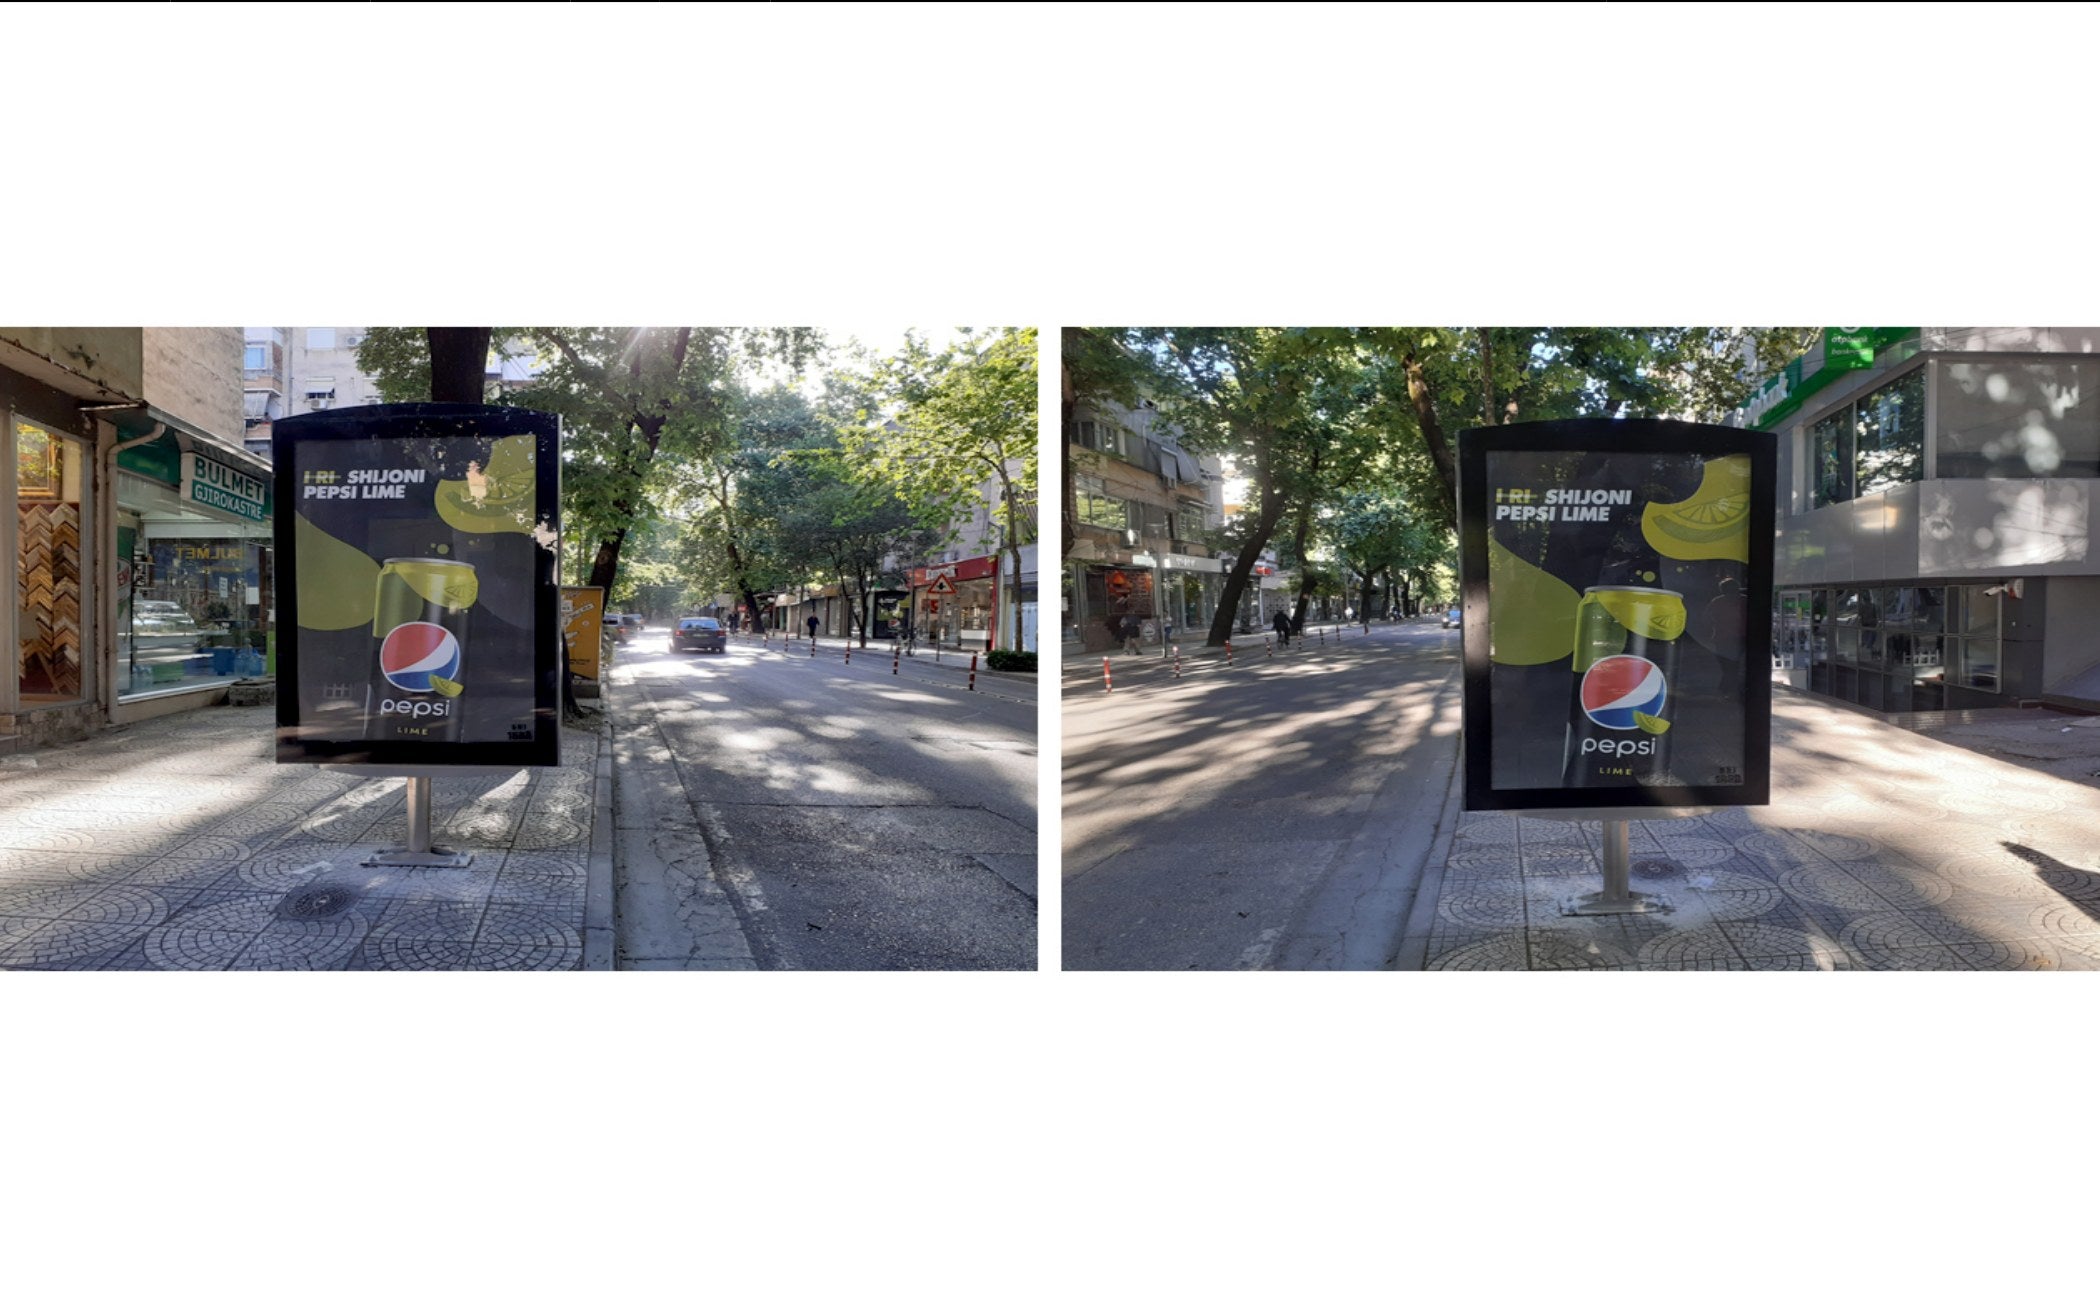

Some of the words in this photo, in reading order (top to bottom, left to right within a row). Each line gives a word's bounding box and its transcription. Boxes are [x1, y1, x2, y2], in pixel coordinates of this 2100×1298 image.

[195, 456, 263, 501] BULMET
[347, 469, 426, 484] SHIJONI
[303, 485, 358, 499] PEPSI
[362, 484, 407, 499] LIME
[1544, 489, 1632, 505] SHIJONI
[194, 484, 262, 520] GJIROKASTRE
[1496, 505, 1556, 522] PEPSI
[1561, 506, 1610, 522] LIME
[380, 699, 450, 719] pepsi
[397, 726, 429, 736] LIME
[1581, 737, 1656, 758] pepsi
[1599, 766, 1633, 776] LIME
